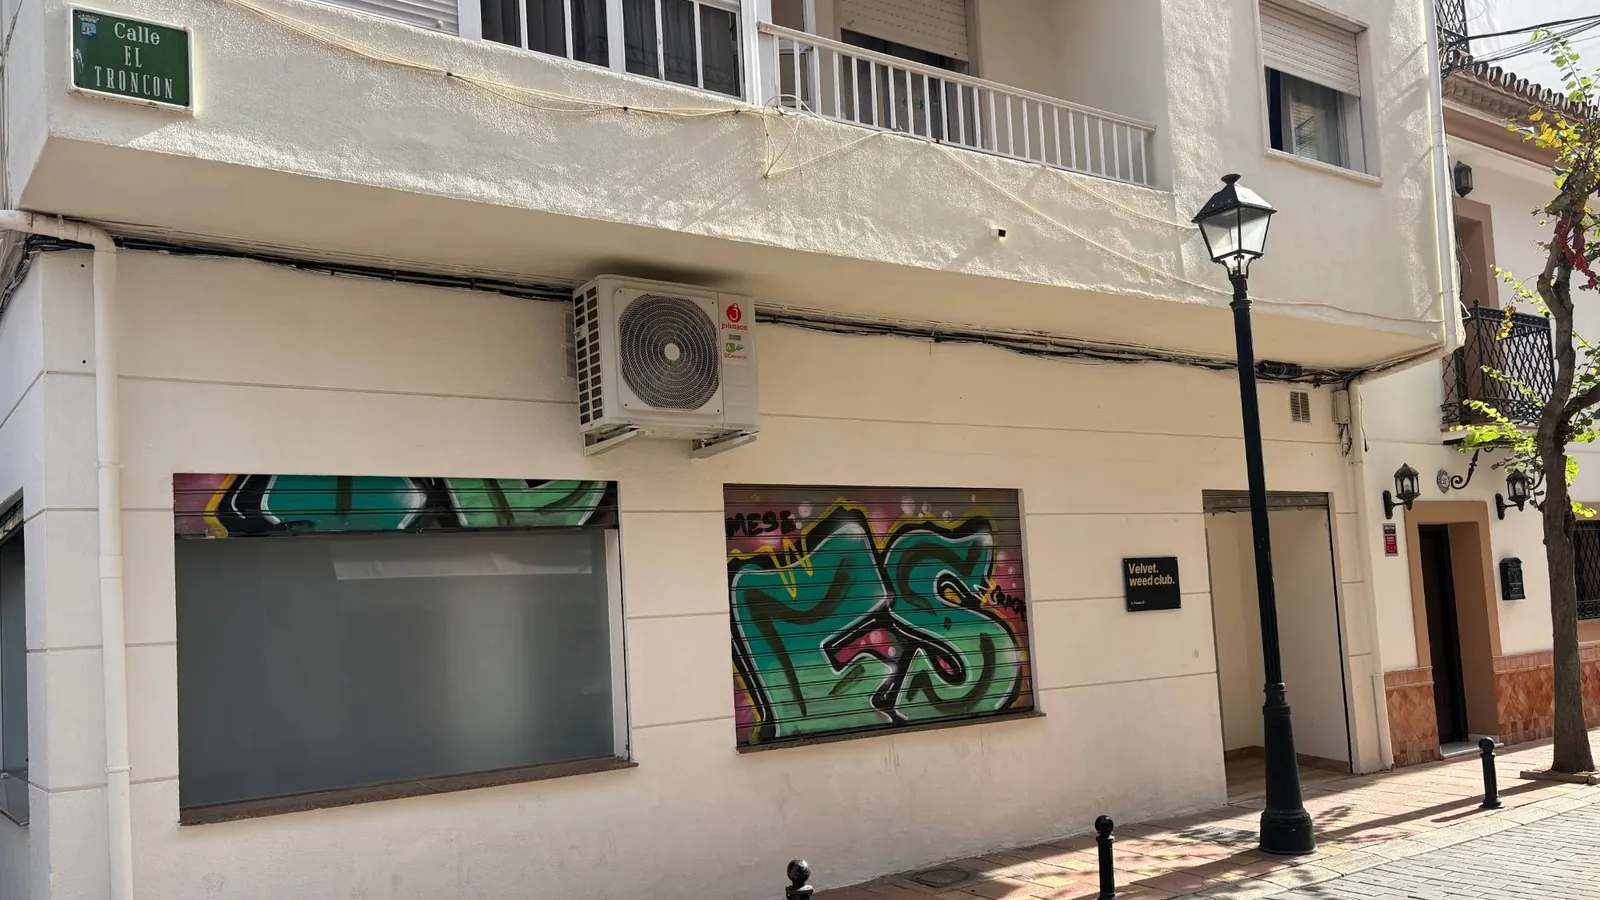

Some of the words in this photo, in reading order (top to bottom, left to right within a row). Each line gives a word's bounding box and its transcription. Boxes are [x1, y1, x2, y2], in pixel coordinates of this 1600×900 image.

[114, 22, 160, 45] Calle
[124, 45, 142, 68] EL
[94, 65, 173, 99] TRONCON
[721, 322, 748, 331] johnson
[1128, 563, 1159, 574] Velvet.
[1129, 574, 1153, 586] weed
[1154, 574, 1175, 585] club.
